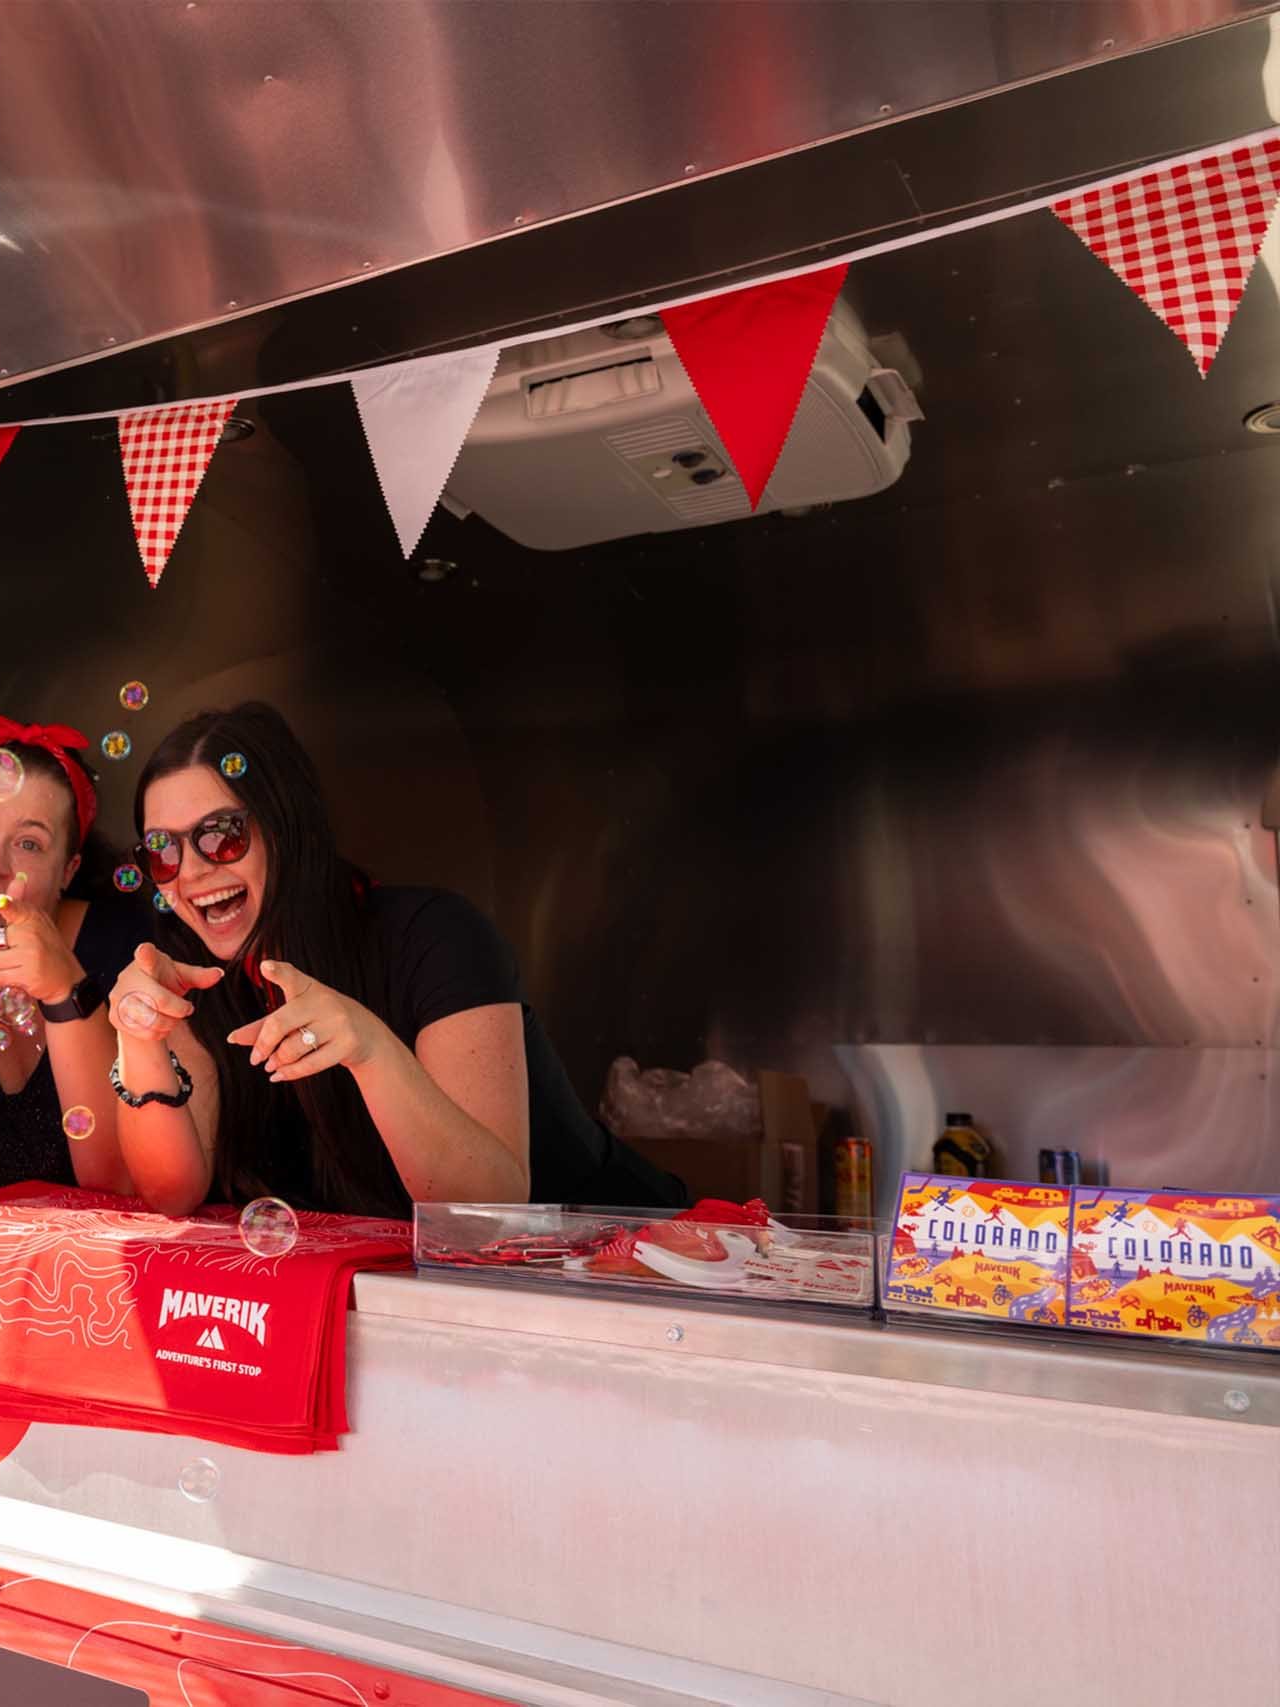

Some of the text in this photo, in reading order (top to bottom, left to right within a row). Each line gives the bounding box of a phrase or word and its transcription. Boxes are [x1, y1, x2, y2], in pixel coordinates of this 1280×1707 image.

[928, 1219, 1058, 1254] COLORADO
[1108, 1237, 1253, 1269] COLORADO
[974, 1262, 1021, 1280] MAVERIK
[1163, 1281, 1216, 1300] MAVERIK
[158, 1287, 270, 1347] MAVERIK
[155, 1348, 262, 1377] ADVENTURE'S FIRST STOP
